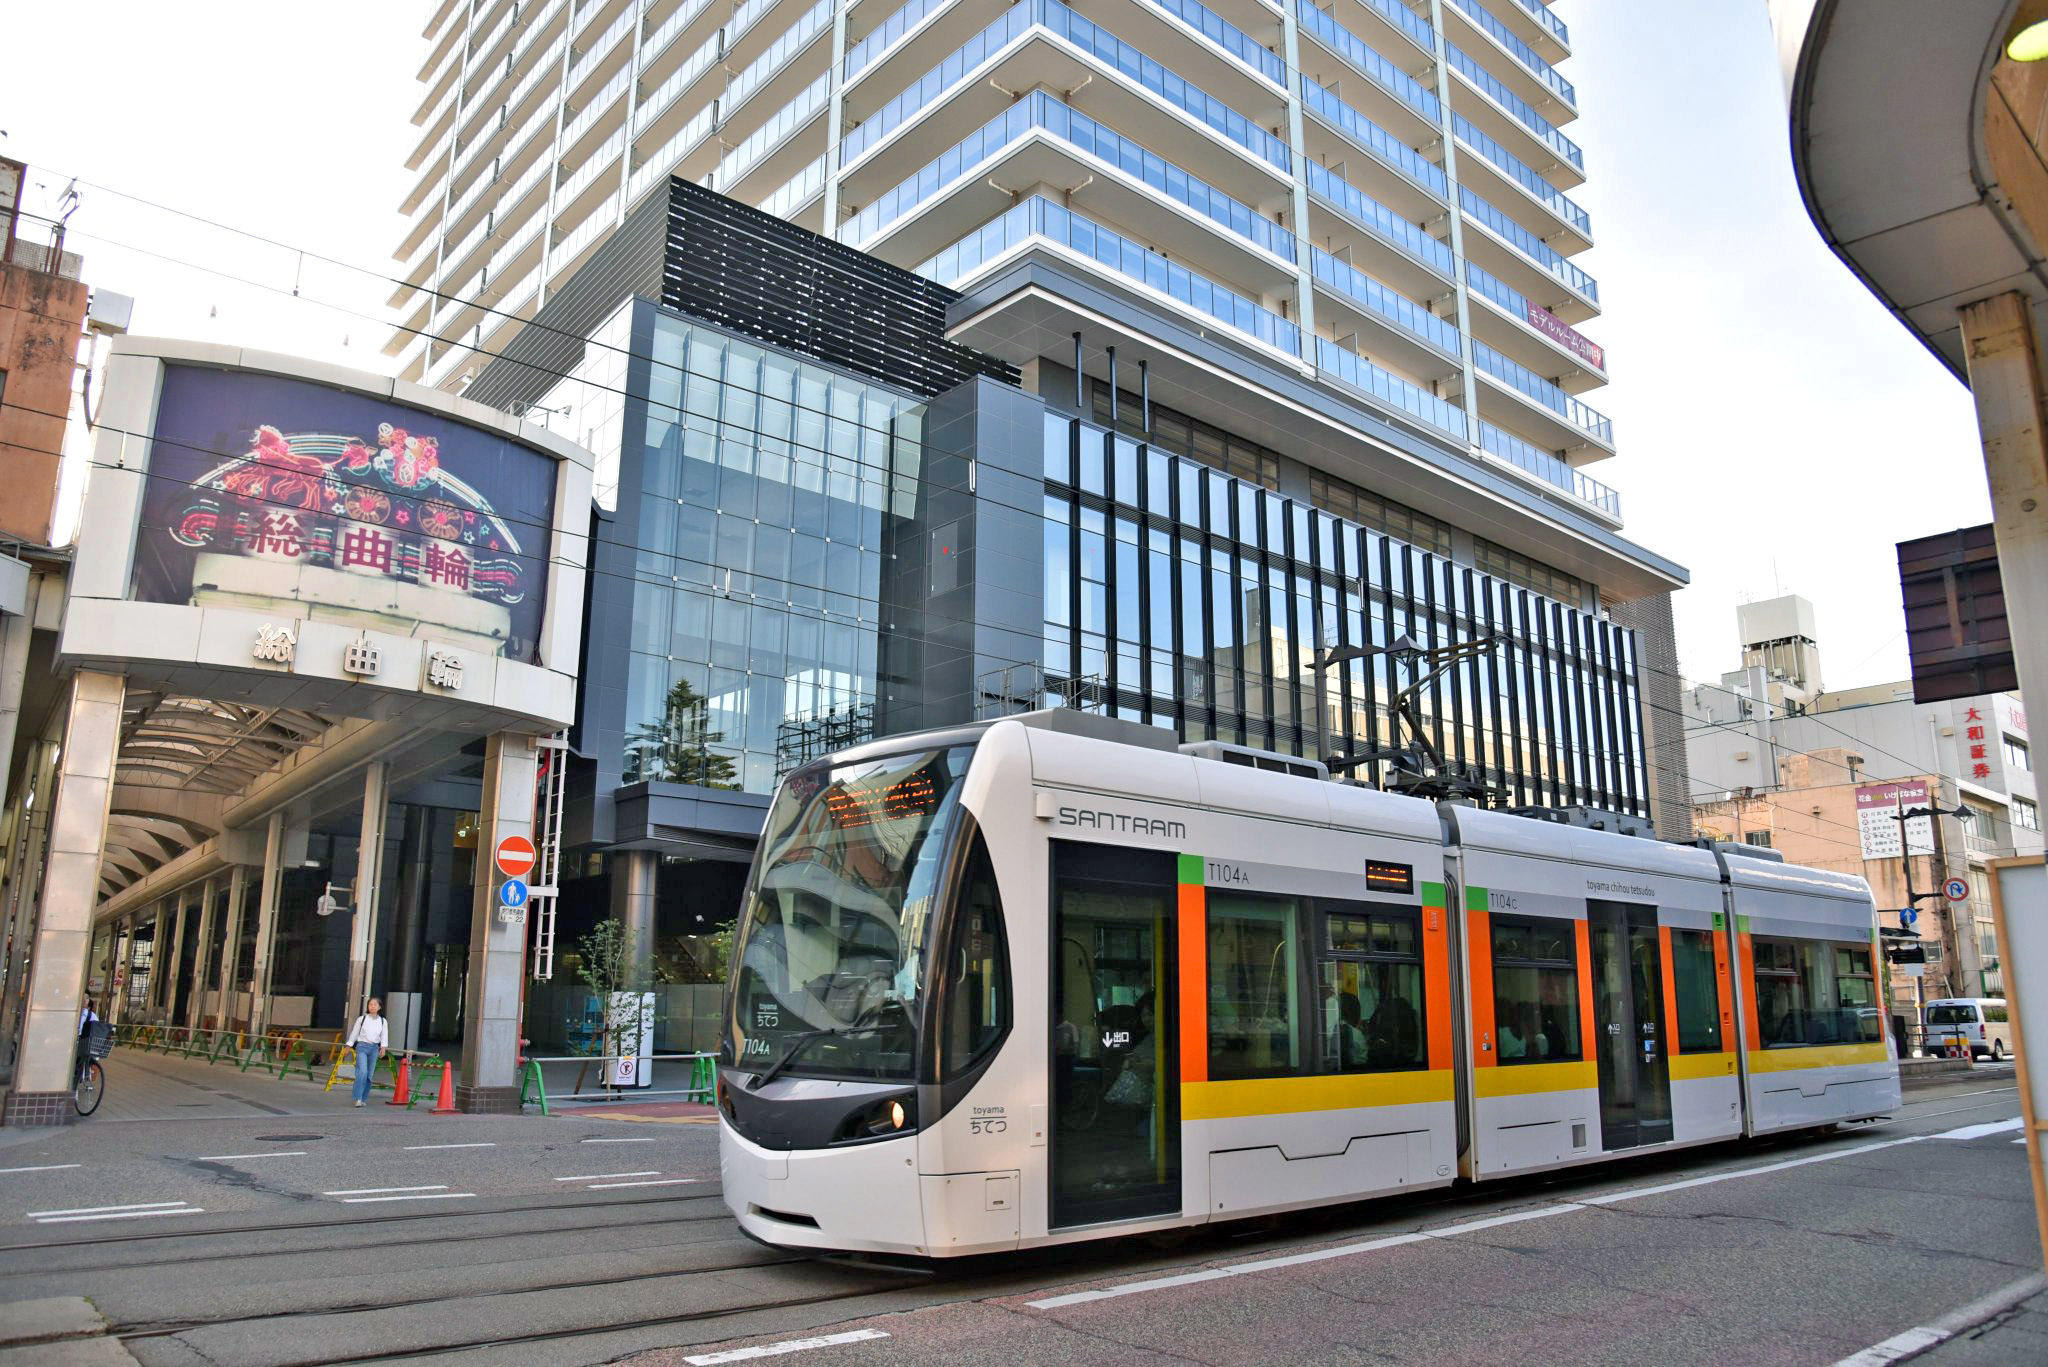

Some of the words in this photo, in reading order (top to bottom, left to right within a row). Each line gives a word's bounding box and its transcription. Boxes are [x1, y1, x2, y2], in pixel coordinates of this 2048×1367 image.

[248, 510, 472, 591] 総曲輪
[253, 622, 464, 690] 総曲輪
[1059, 806, 1186, 840] SANTRAM
[1208, 862, 1250, 885] T104A
[1586, 880, 1610, 893] toyama
[1611, 881, 1630, 894] chihou
[1631, 884, 1655, 897] tetsudou
[757, 1014, 779, 1027] ちてつ
[1113, 1031, 1130, 1043] 出口
[743, 1038, 770, 1055] T104A
[973, 1106, 1005, 1116] toyama
[970, 1120, 1007, 1135] ちてつ
